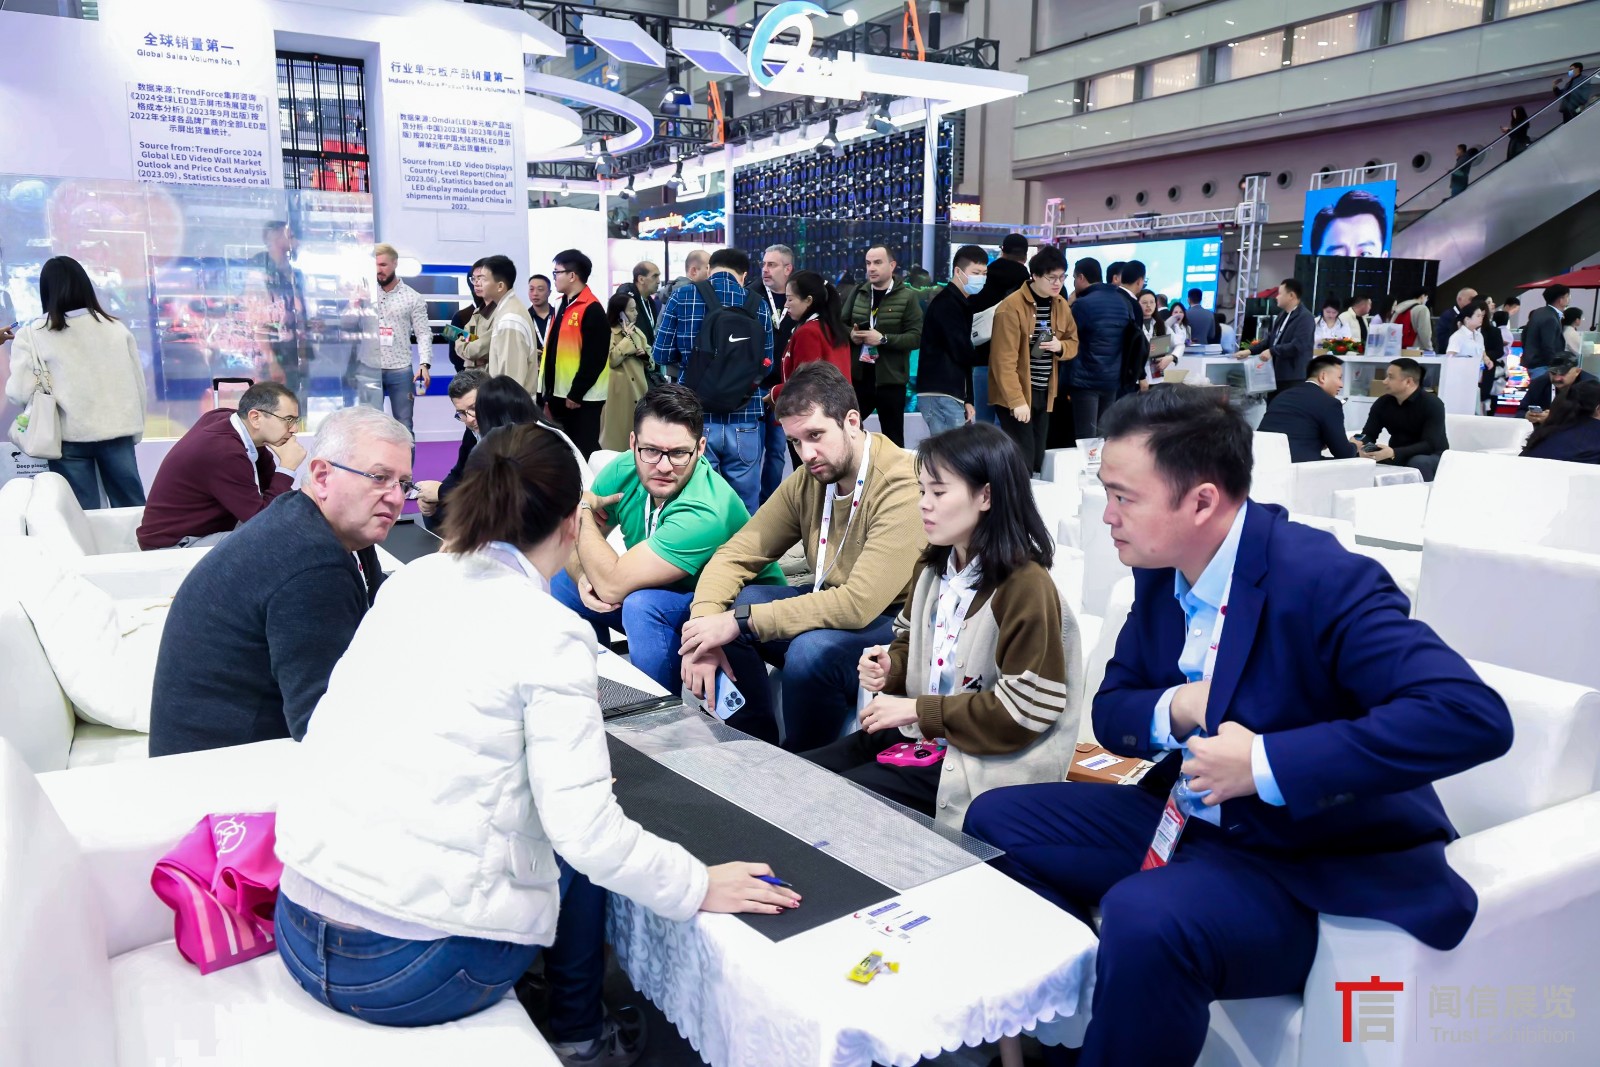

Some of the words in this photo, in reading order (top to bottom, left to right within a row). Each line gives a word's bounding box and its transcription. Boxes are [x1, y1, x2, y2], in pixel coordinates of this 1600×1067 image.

[144, 32, 234, 52] 全球销量第一
[137, 49, 164, 58] Global
[166, 52, 188, 61] Sales
[190, 54, 219, 64] Volume
[391, 61, 514, 82] 行业单元板产品销量第一
[130, 91, 264, 112] 《2024全球LED显示屏市场展望与价
[129, 111, 267, 131] 2022年全球各品牌厂商的全部LED显
[169, 124, 231, 137] 示屏出货量统计。
[139, 141, 169, 151] Source
[243, 150, 262, 158] 2024
[141, 151, 169, 160] Global
[171, 153, 187, 161] LED
[189, 154, 212, 163] Video
[213, 156, 232, 165] Wall
[233, 158, 261, 167] Market
[402, 157, 427, 166] Source
[464, 161, 484, 169] Video
[485, 163, 513, 172] Displays
[137, 160, 171, 170] Outlook
[173, 163, 190, 171] and
[191, 164, 212, 174] Price
[214, 166, 232, 174] Cost
[234, 167, 267, 177] Analysis
[409, 167, 459, 176] Country-Level
[183, 174, 221, 183] Statistics
[222, 175, 246, 184] based
[260, 178, 270, 186] all
[441, 178, 472, 186] Statistics
[474, 179, 494, 187] based
[406, 192, 442, 201] shipments
[452, 195, 484, 203] mainland
[485, 196, 505, 204] China
[427, 185, 452, 194] display
[453, 186, 479, 194] module
[480, 188, 506, 197] product
